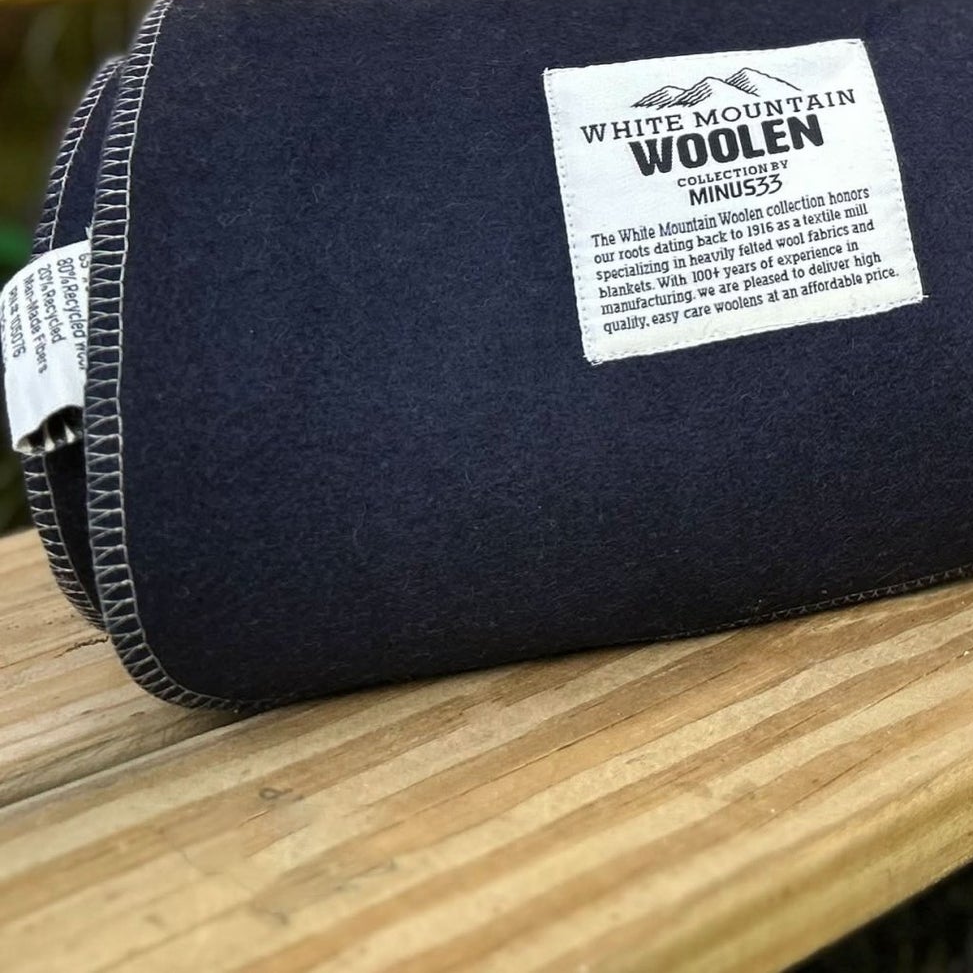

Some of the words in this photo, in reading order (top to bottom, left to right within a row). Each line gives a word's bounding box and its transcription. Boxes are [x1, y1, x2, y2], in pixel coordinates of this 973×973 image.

[580, 114, 684, 143] WHITE
[694, 89, 855, 127] MOUNTAIN
[628, 113, 824, 177] WOOLEN
[677, 163, 768, 188] COLLECTION
[770, 159, 788, 171] BY
[689, 174, 782, 206] MINUS33
[590, 233, 616, 248] The
[618, 226, 656, 243] White
[658, 217, 717, 237] Mountain
[717, 208, 764, 225] Woolen
[766, 196, 825, 217] collection
[828, 188, 870, 205] honors
[593, 251, 615, 265] our
[618, 245, 651, 260] roots
[653, 238, 694, 255] dating
[696, 230, 728, 248] back
[730, 228, 744, 241] to
[747, 221, 774, 238] 1916
[776, 220, 791, 231] as
[792, 218, 802, 228] a
[802, 209, 841, 225] textile
[844, 203, 869, 219] mill
[596, 260, 670, 282] specializing
[672, 258, 687, 269] in
[688, 247, 735, 267] heavily
[738, 238, 773, 257] felted
[775, 232, 805, 248] wool
[807, 225, 850, 243] fabrics
[851, 219, 875, 234] and
[598, 280, 655, 299] blankets.
[657, 274, 688, 289] With
[692, 267, 720, 283] 100+
[723, 261, 757, 279] years
[760, 255, 774, 270] of
[777, 245, 843, 266] experience
[846, 241, 859, 252] in
[697, 286, 716, 298] we
[718, 281, 740, 294] are
[743, 269, 790, 291] pleased
[791, 267, 805, 279] to
[808, 259, 850, 276] deliver
[853, 251, 882, 268] high
[23, 273, 42, 334] Man-Made
[42, 289, 67, 344] Recycled
[62, 284, 88, 338] Recycled
[651, 310, 679, 325] easy
[683, 305, 711, 319] care
[714, 294, 764, 313] woolens
[767, 289, 780, 303] at
[781, 287, 799, 300] an
[800, 273, 863, 296] affordable
[864, 268, 899, 284] price.
[32, 333, 48, 374] Fibers
